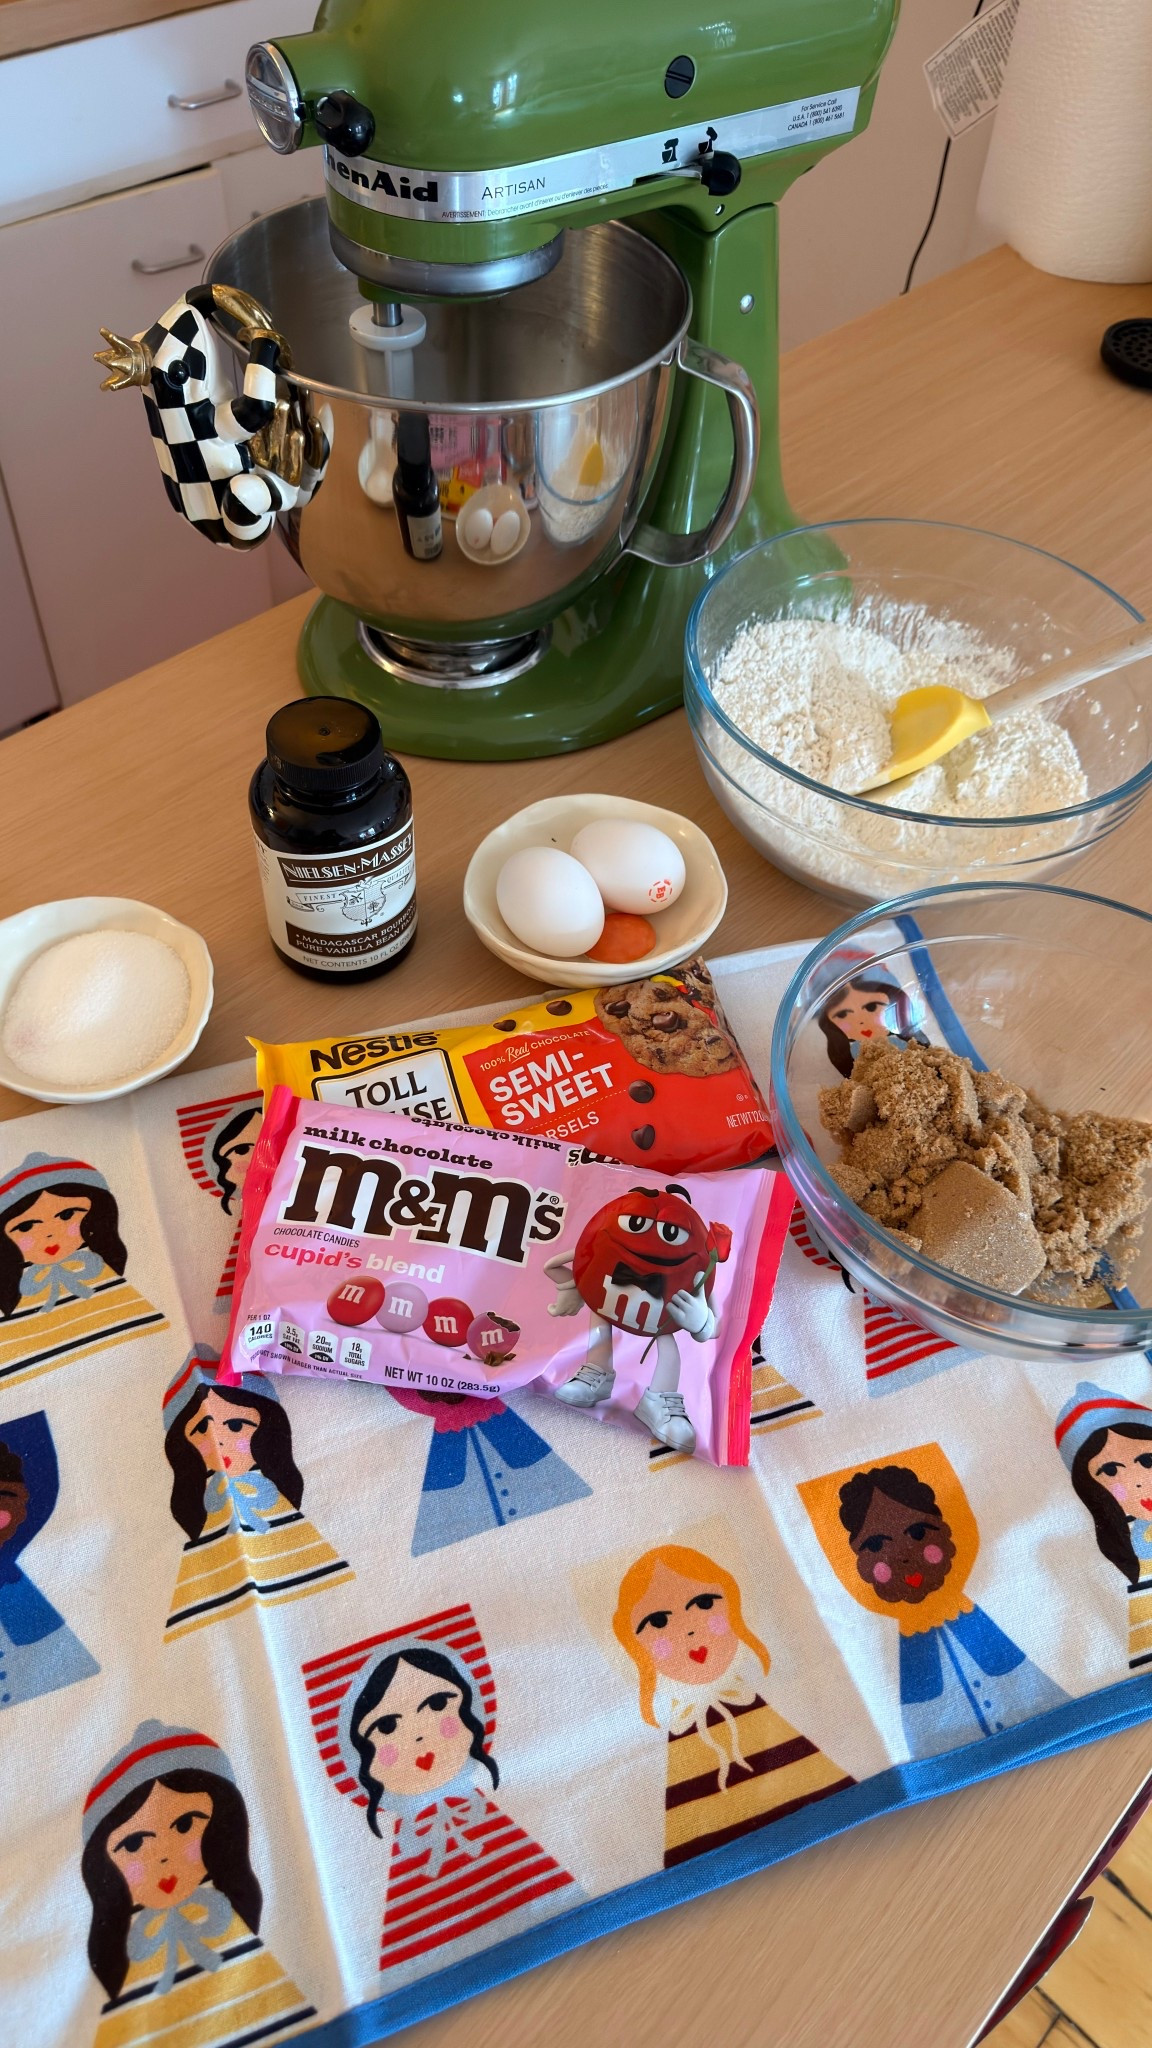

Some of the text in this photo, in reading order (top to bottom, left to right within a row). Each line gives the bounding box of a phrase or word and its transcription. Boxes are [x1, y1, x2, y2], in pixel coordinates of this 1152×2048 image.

[810, 102, 826, 110] Service
[788, 121, 808, 131] CANADA
[481, 177, 546, 200] ARTISAN
[303, 894, 336, 902] FINEST
[296, 940, 323, 953] PURE
[325, 943, 374, 954] VANILLA
[375, 930, 400, 947] BEAN
[302, 933, 378, 947] MADAGASCAR
[303, 956, 319, 965] NET
[320, 959, 368, 968] CONTENTS
[390, 944, 399, 953] OZ
[480, 1030, 591, 1072] 100% Real CHOCOLATE
[489, 1050, 585, 1102] SEMI-
[345, 1071, 428, 1109] TOLL
[501, 1062, 614, 1126] SWEET
[726, 1114, 741, 1129] NET
[740, 1112, 753, 1125] WT
[411, 1117, 562, 1153] milk chocolate
[303, 1126, 494, 1170] milk chocolate
[283, 1145, 565, 1264] m&m's
[273, 1227, 361, 1249] CHOCOLATE CANDIES
[264, 1243, 446, 1284] cupid's blend
[338, 1283, 366, 1304] m
[597, 1274, 664, 1334] m
[388, 1296, 414, 1319] m
[249, 1324, 272, 1337] 140
[286, 1325, 299, 1338] 3.5g
[434, 1315, 459, 1334] m
[247, 1333, 273, 1343] CALORIES
[315, 1335, 332, 1347] 20mg
[351, 1342, 363, 1354] 18g
[480, 1328, 505, 1347] m
[312, 1344, 333, 1354] SODIUM
[348, 1352, 363, 1360] TOTAL
[270, 1352, 291, 1363] SHOWN
[291, 1358, 312, 1370] LARGER
[312, 1365, 328, 1373] THAN
[328, 1368, 349, 1378] ACTUAL
[344, 1358, 366, 1367] SUGARS
[384, 1366, 501, 1393] NET WT 10 OZ (283.5g)
